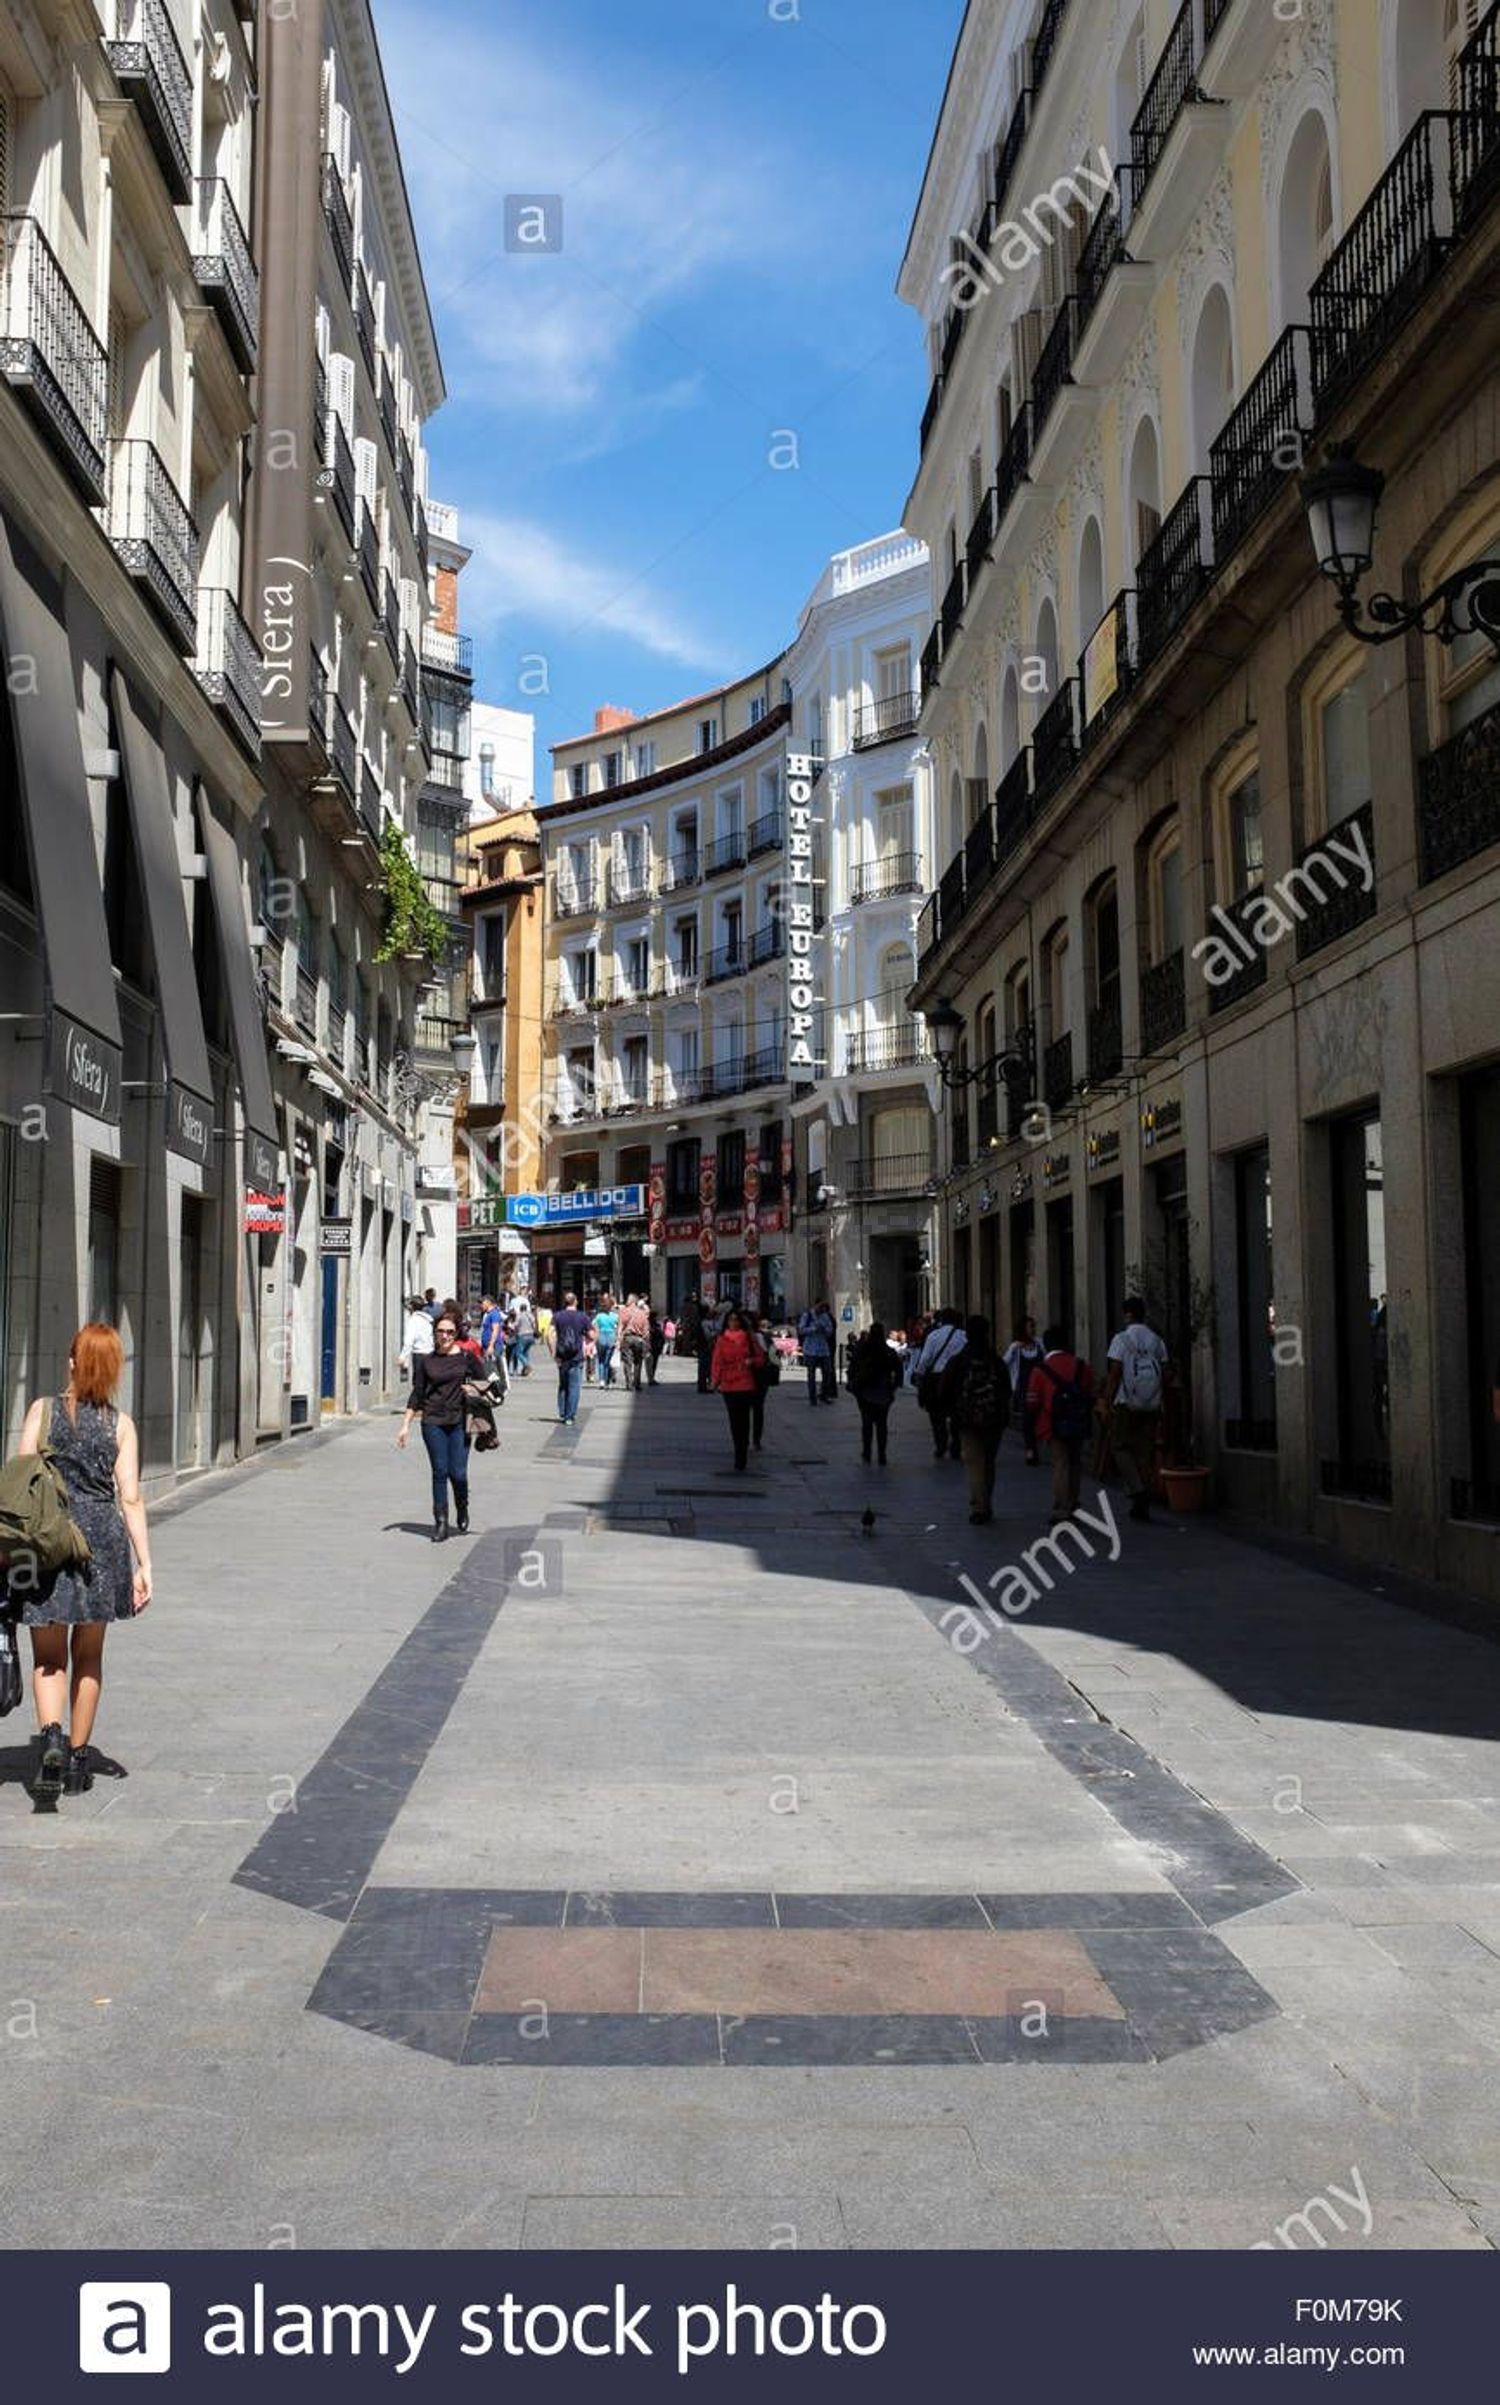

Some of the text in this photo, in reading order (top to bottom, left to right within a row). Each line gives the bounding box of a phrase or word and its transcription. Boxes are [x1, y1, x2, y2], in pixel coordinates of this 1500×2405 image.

[788, 754, 814, 1063] HOTEL EUROPA
[549, 1188, 626, 1212] BELLIDO
